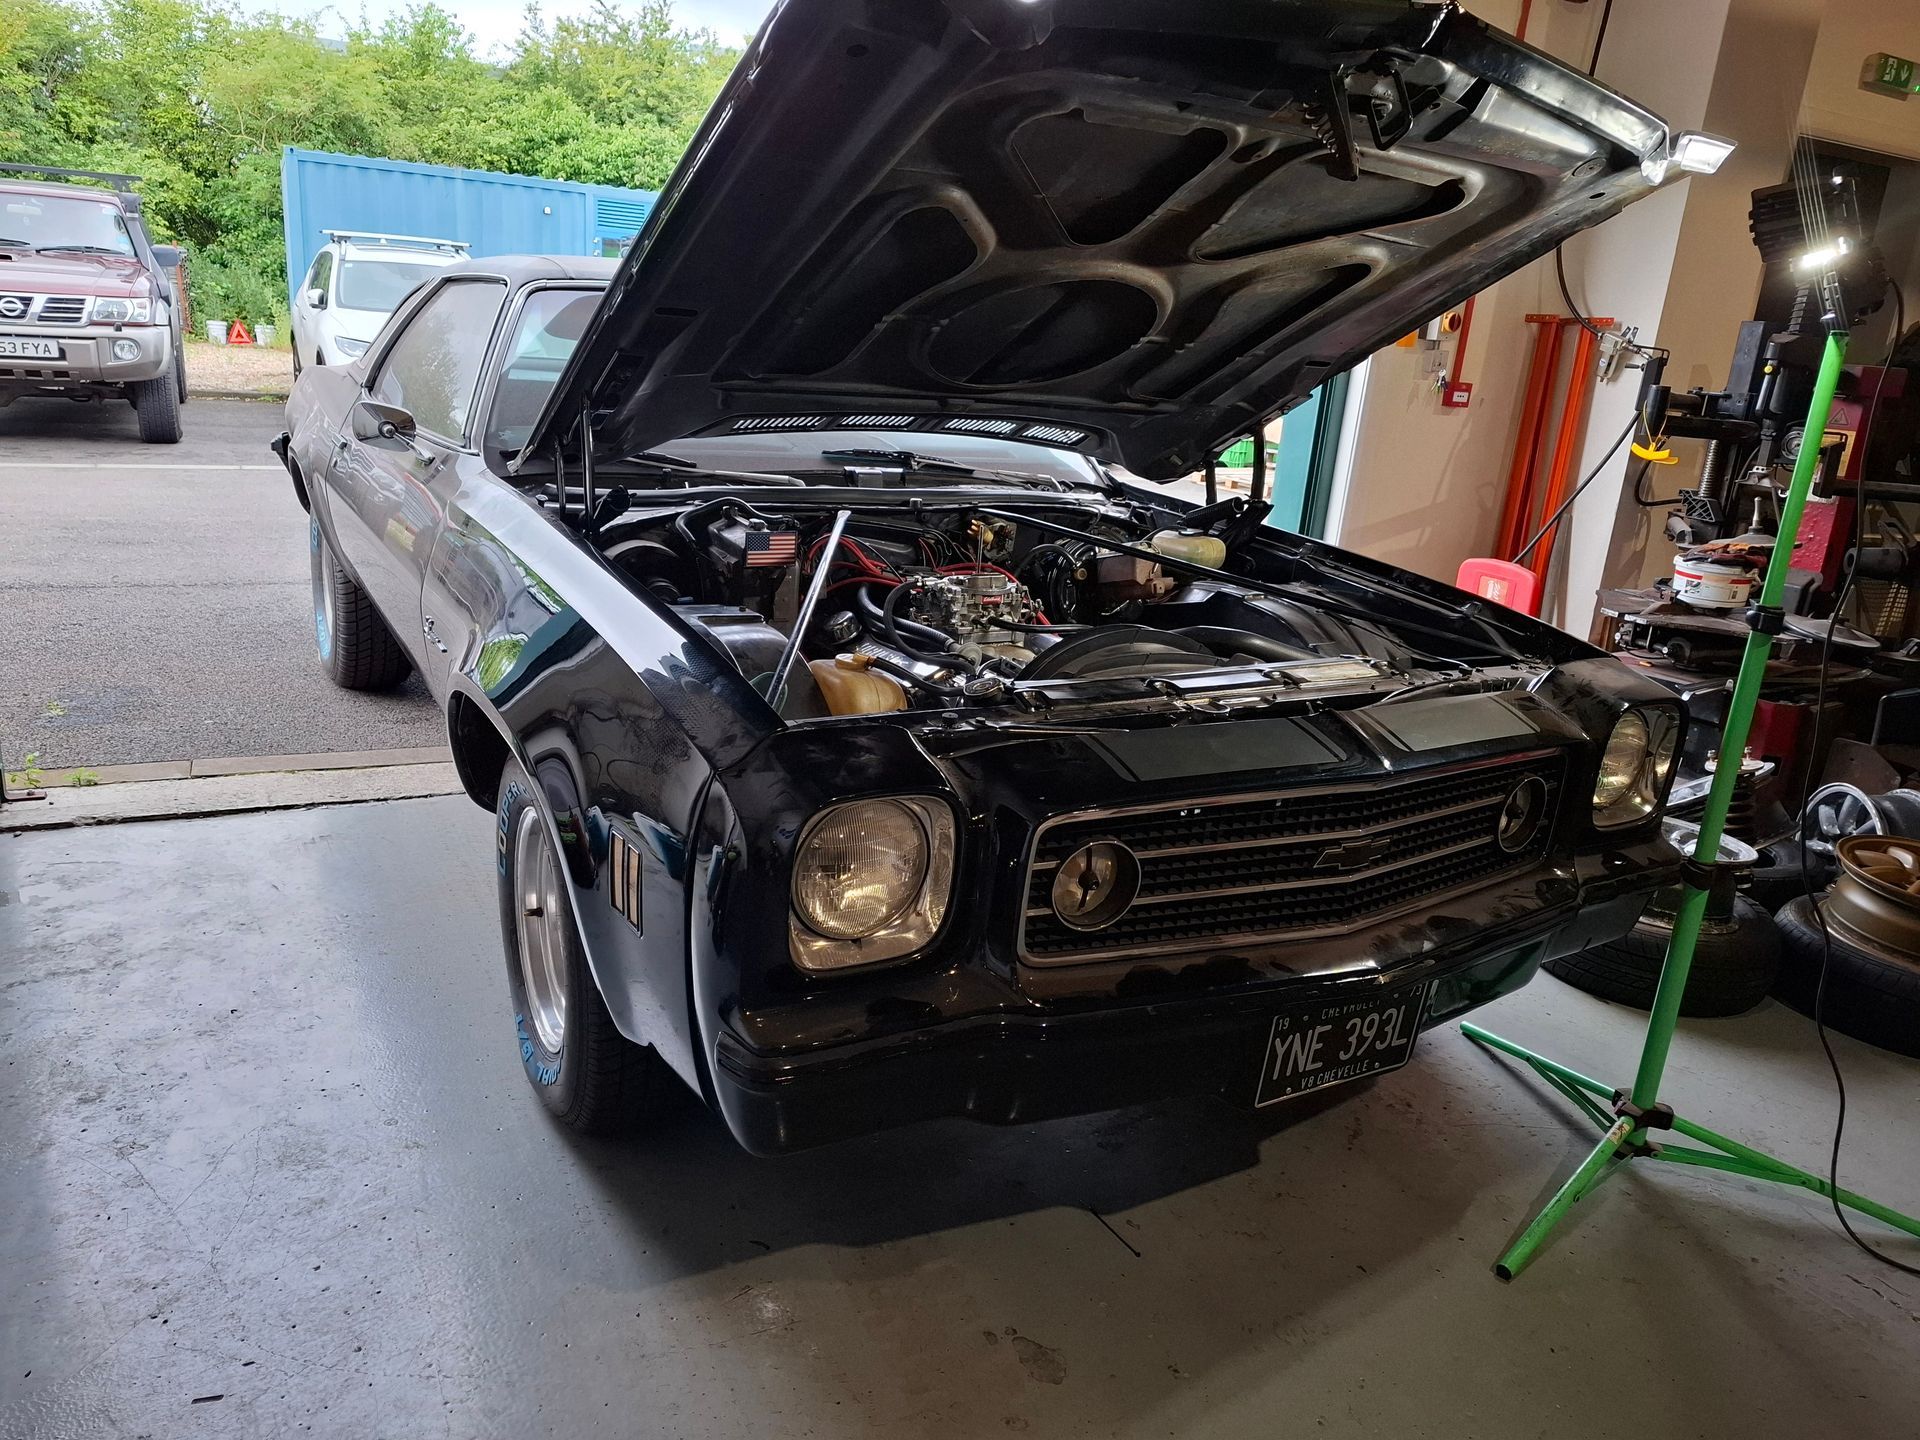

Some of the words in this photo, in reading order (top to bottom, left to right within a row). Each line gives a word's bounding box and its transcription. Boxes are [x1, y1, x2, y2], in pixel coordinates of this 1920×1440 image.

[21, 342, 52, 355] FYA
[498, 780, 521, 877] COOPER
[1278, 1017, 1290, 1031] 19
[1273, 1025, 1332, 1080] YNE
[1339, 1005, 1407, 1061] 393L
[1301, 1076, 1314, 1090] V8
[1316, 1060, 1370, 1086] CHEVELLE
